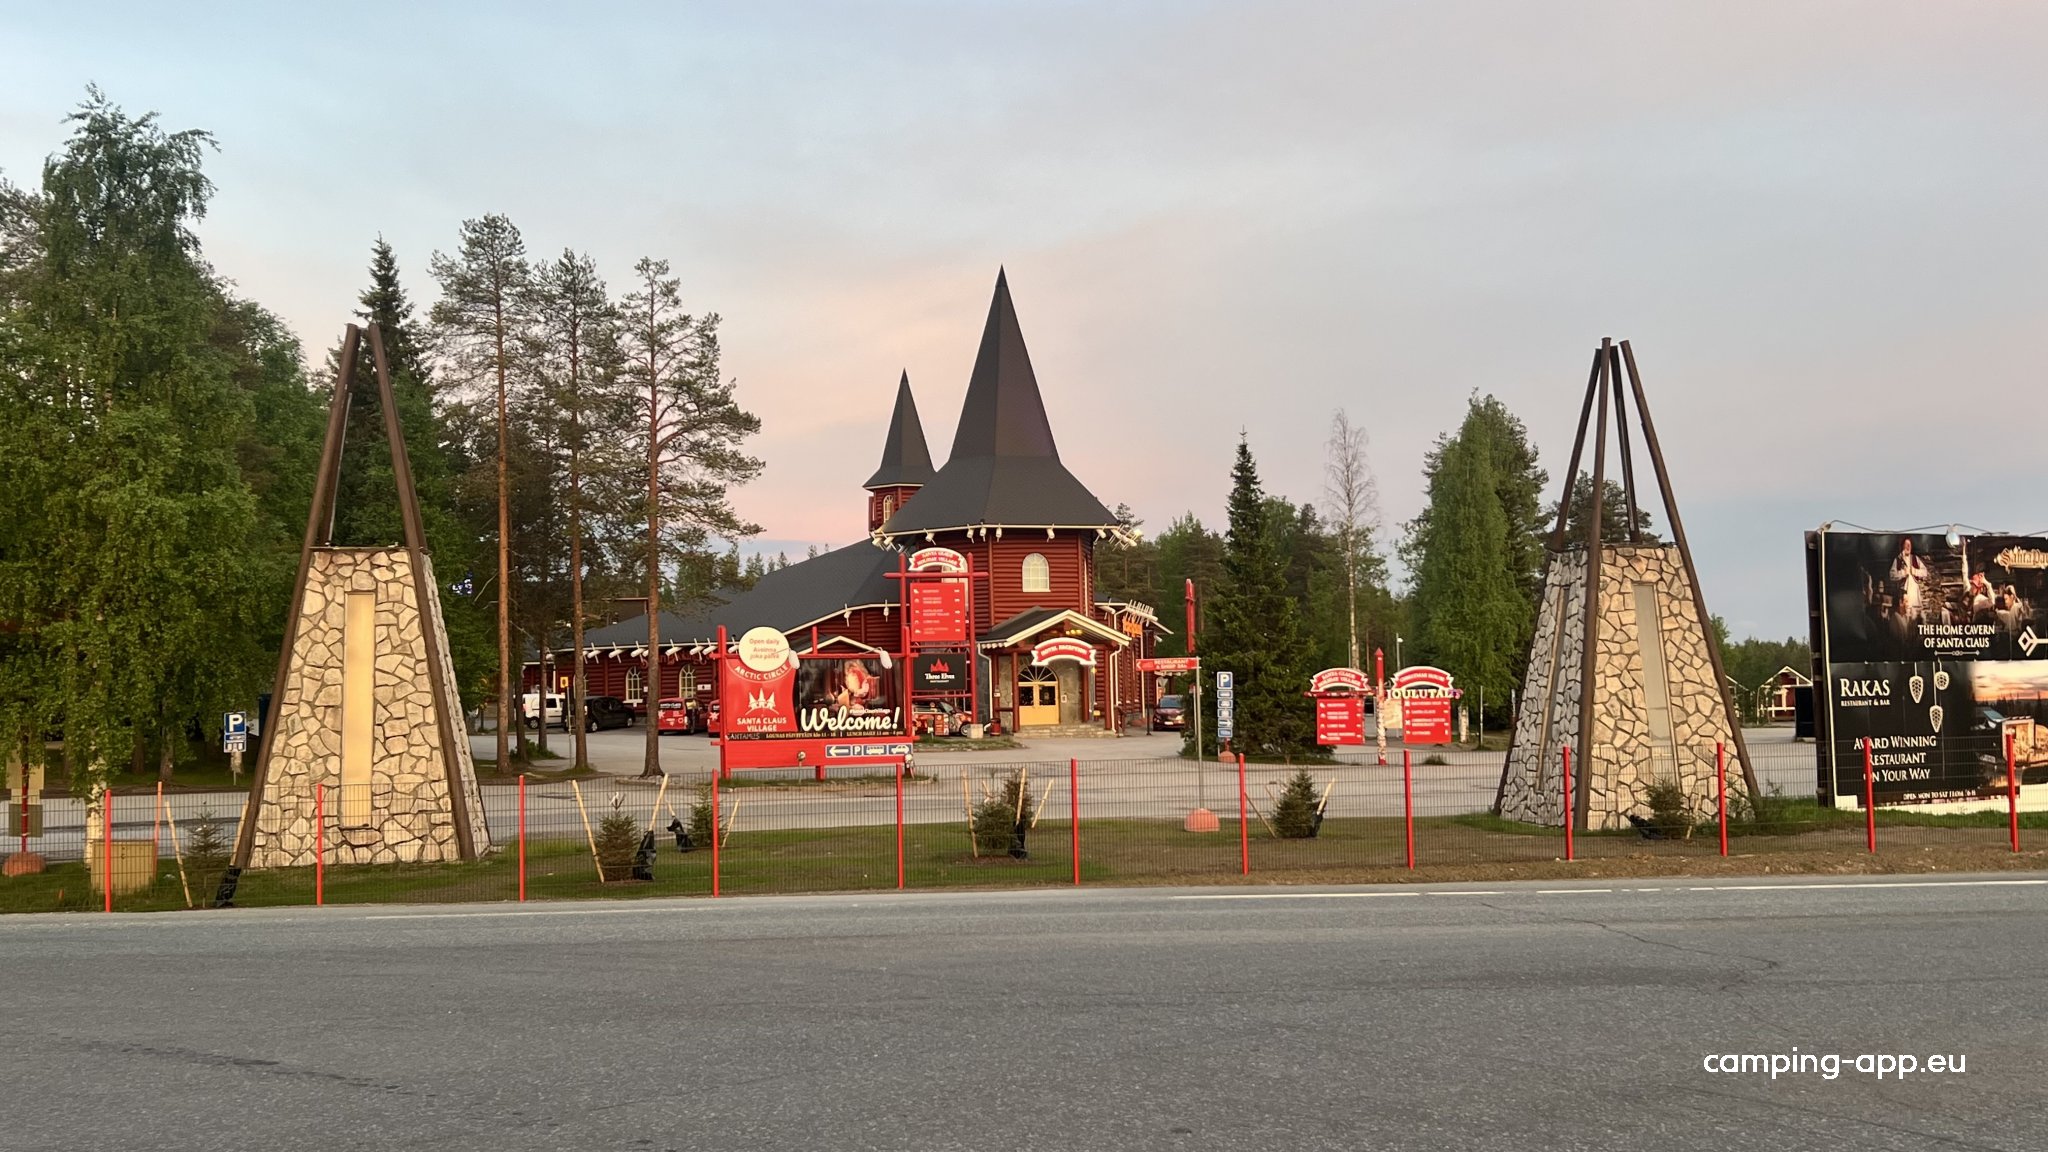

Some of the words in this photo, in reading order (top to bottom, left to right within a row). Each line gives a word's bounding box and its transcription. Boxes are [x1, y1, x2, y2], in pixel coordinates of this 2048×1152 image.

[1998, 547, 2048, 567] SantaPa
[1918, 625, 1934, 635] THE
[1936, 625, 1963, 635] HOME
[1964, 624, 1995, 635] CAVERN
[1924, 638, 1936, 648] OF
[1936, 637, 1964, 648] SANTA
[1965, 637, 1990, 647] CLAUS
[734, 666, 762, 680] ARCTIC
[763, 664, 788, 680] CIRCLE
[1220, 674, 1230, 687] P
[1840, 678, 1891, 697] RAKAS
[229, 714, 243, 732] P
[737, 717, 762, 725] SANTA
[763, 717, 787, 725] CLAUS
[800, 705, 900, 732] Welcome!
[747, 724, 777, 732] VILLAGE
[1890, 735, 1937, 748] WINNING
[854, 746, 861, 755] P
[1863, 771, 1880, 783] N
[1881, 769, 1907, 782] YOUR
[1908, 767, 1931, 780] WAY
